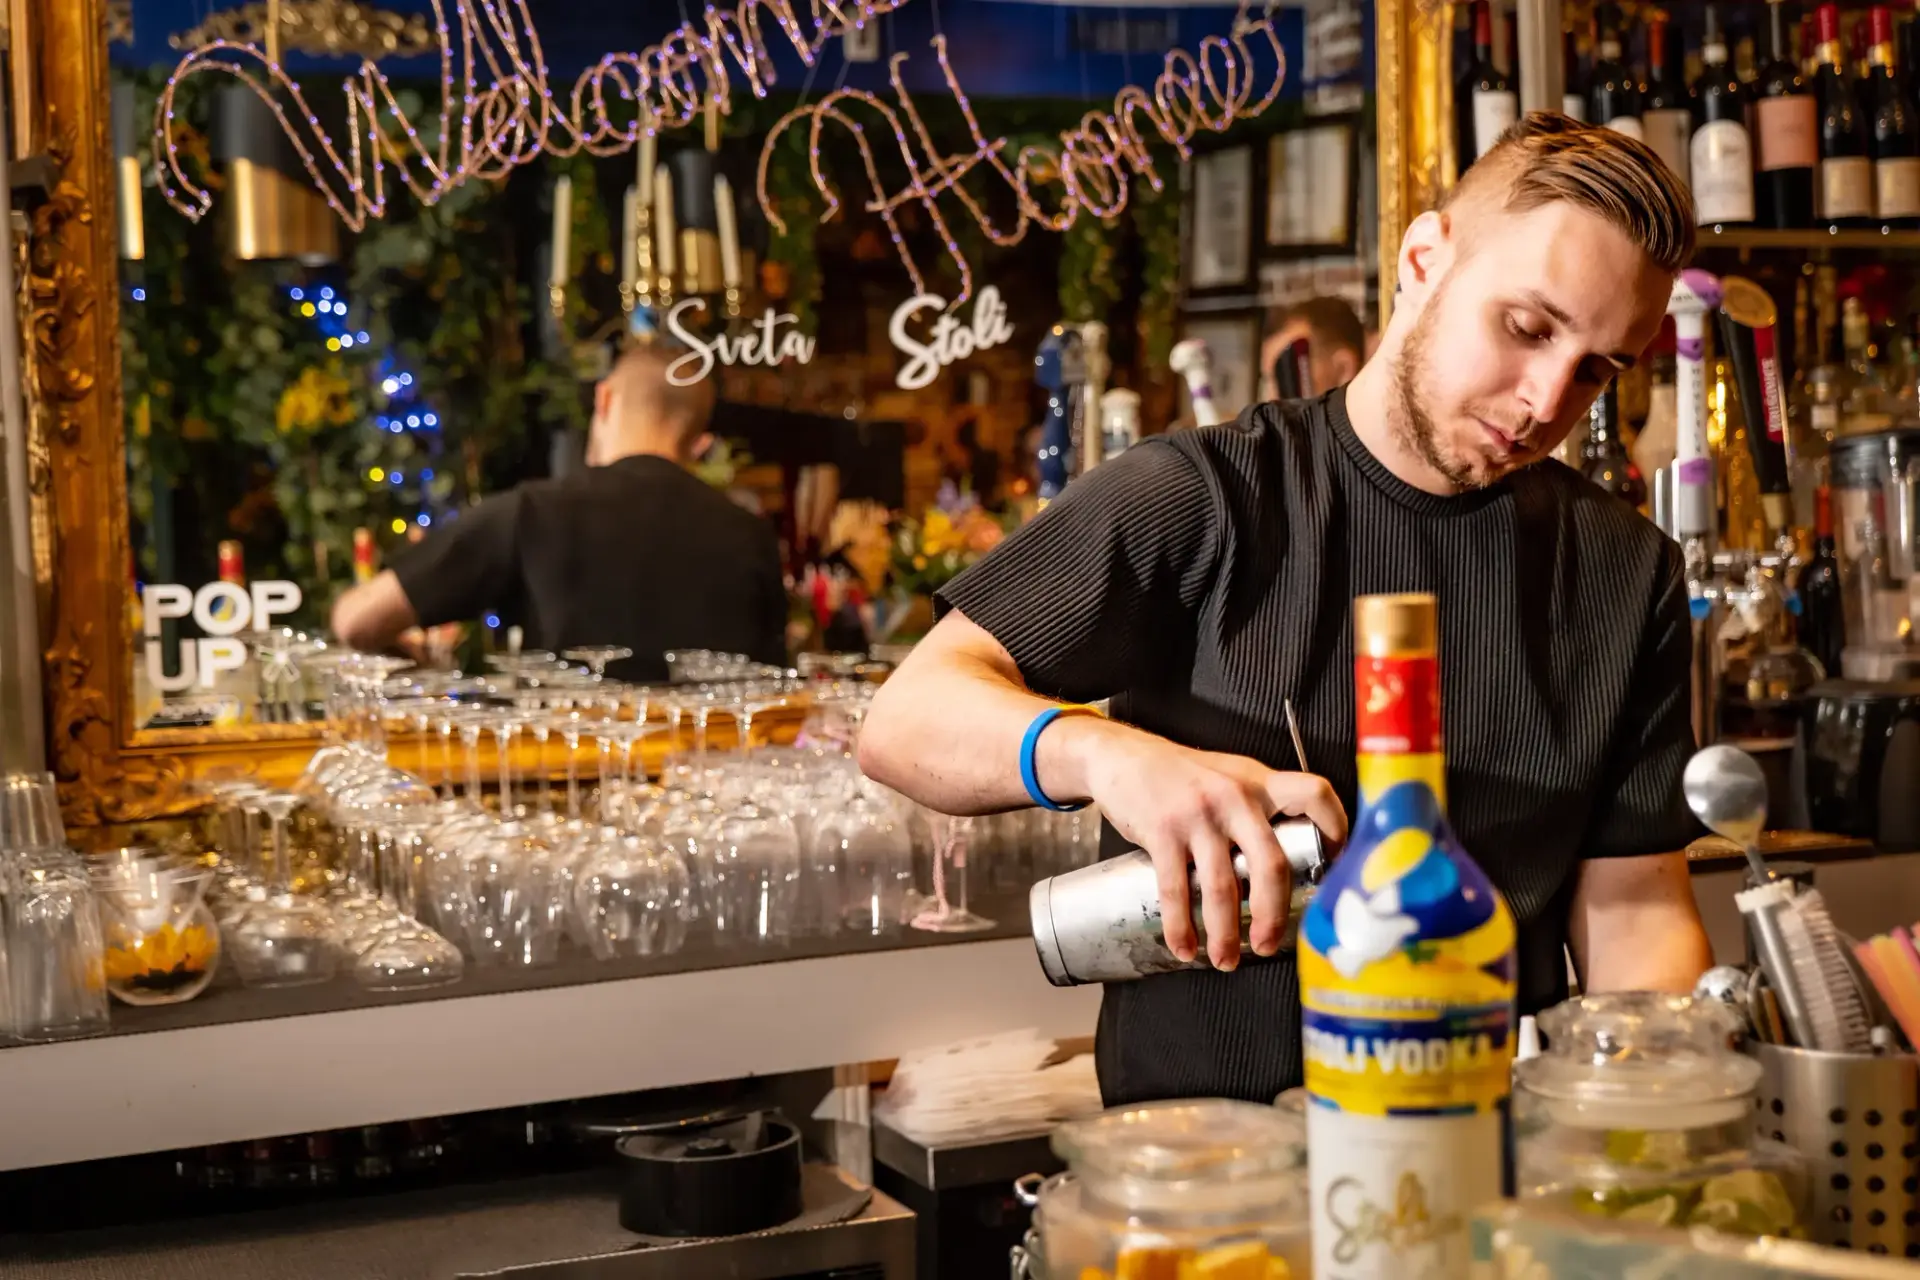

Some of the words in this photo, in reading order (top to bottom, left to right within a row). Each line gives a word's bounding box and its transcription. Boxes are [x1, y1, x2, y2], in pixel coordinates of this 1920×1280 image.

[757, 18, 1287, 308] Home
[665, 297, 816, 387] Sveta
[888, 284, 1015, 390] Stoli
[143, 579, 302, 636] POP
[144, 637, 247, 691] UP
[1371, 1033, 1492, 1076] VODKA
